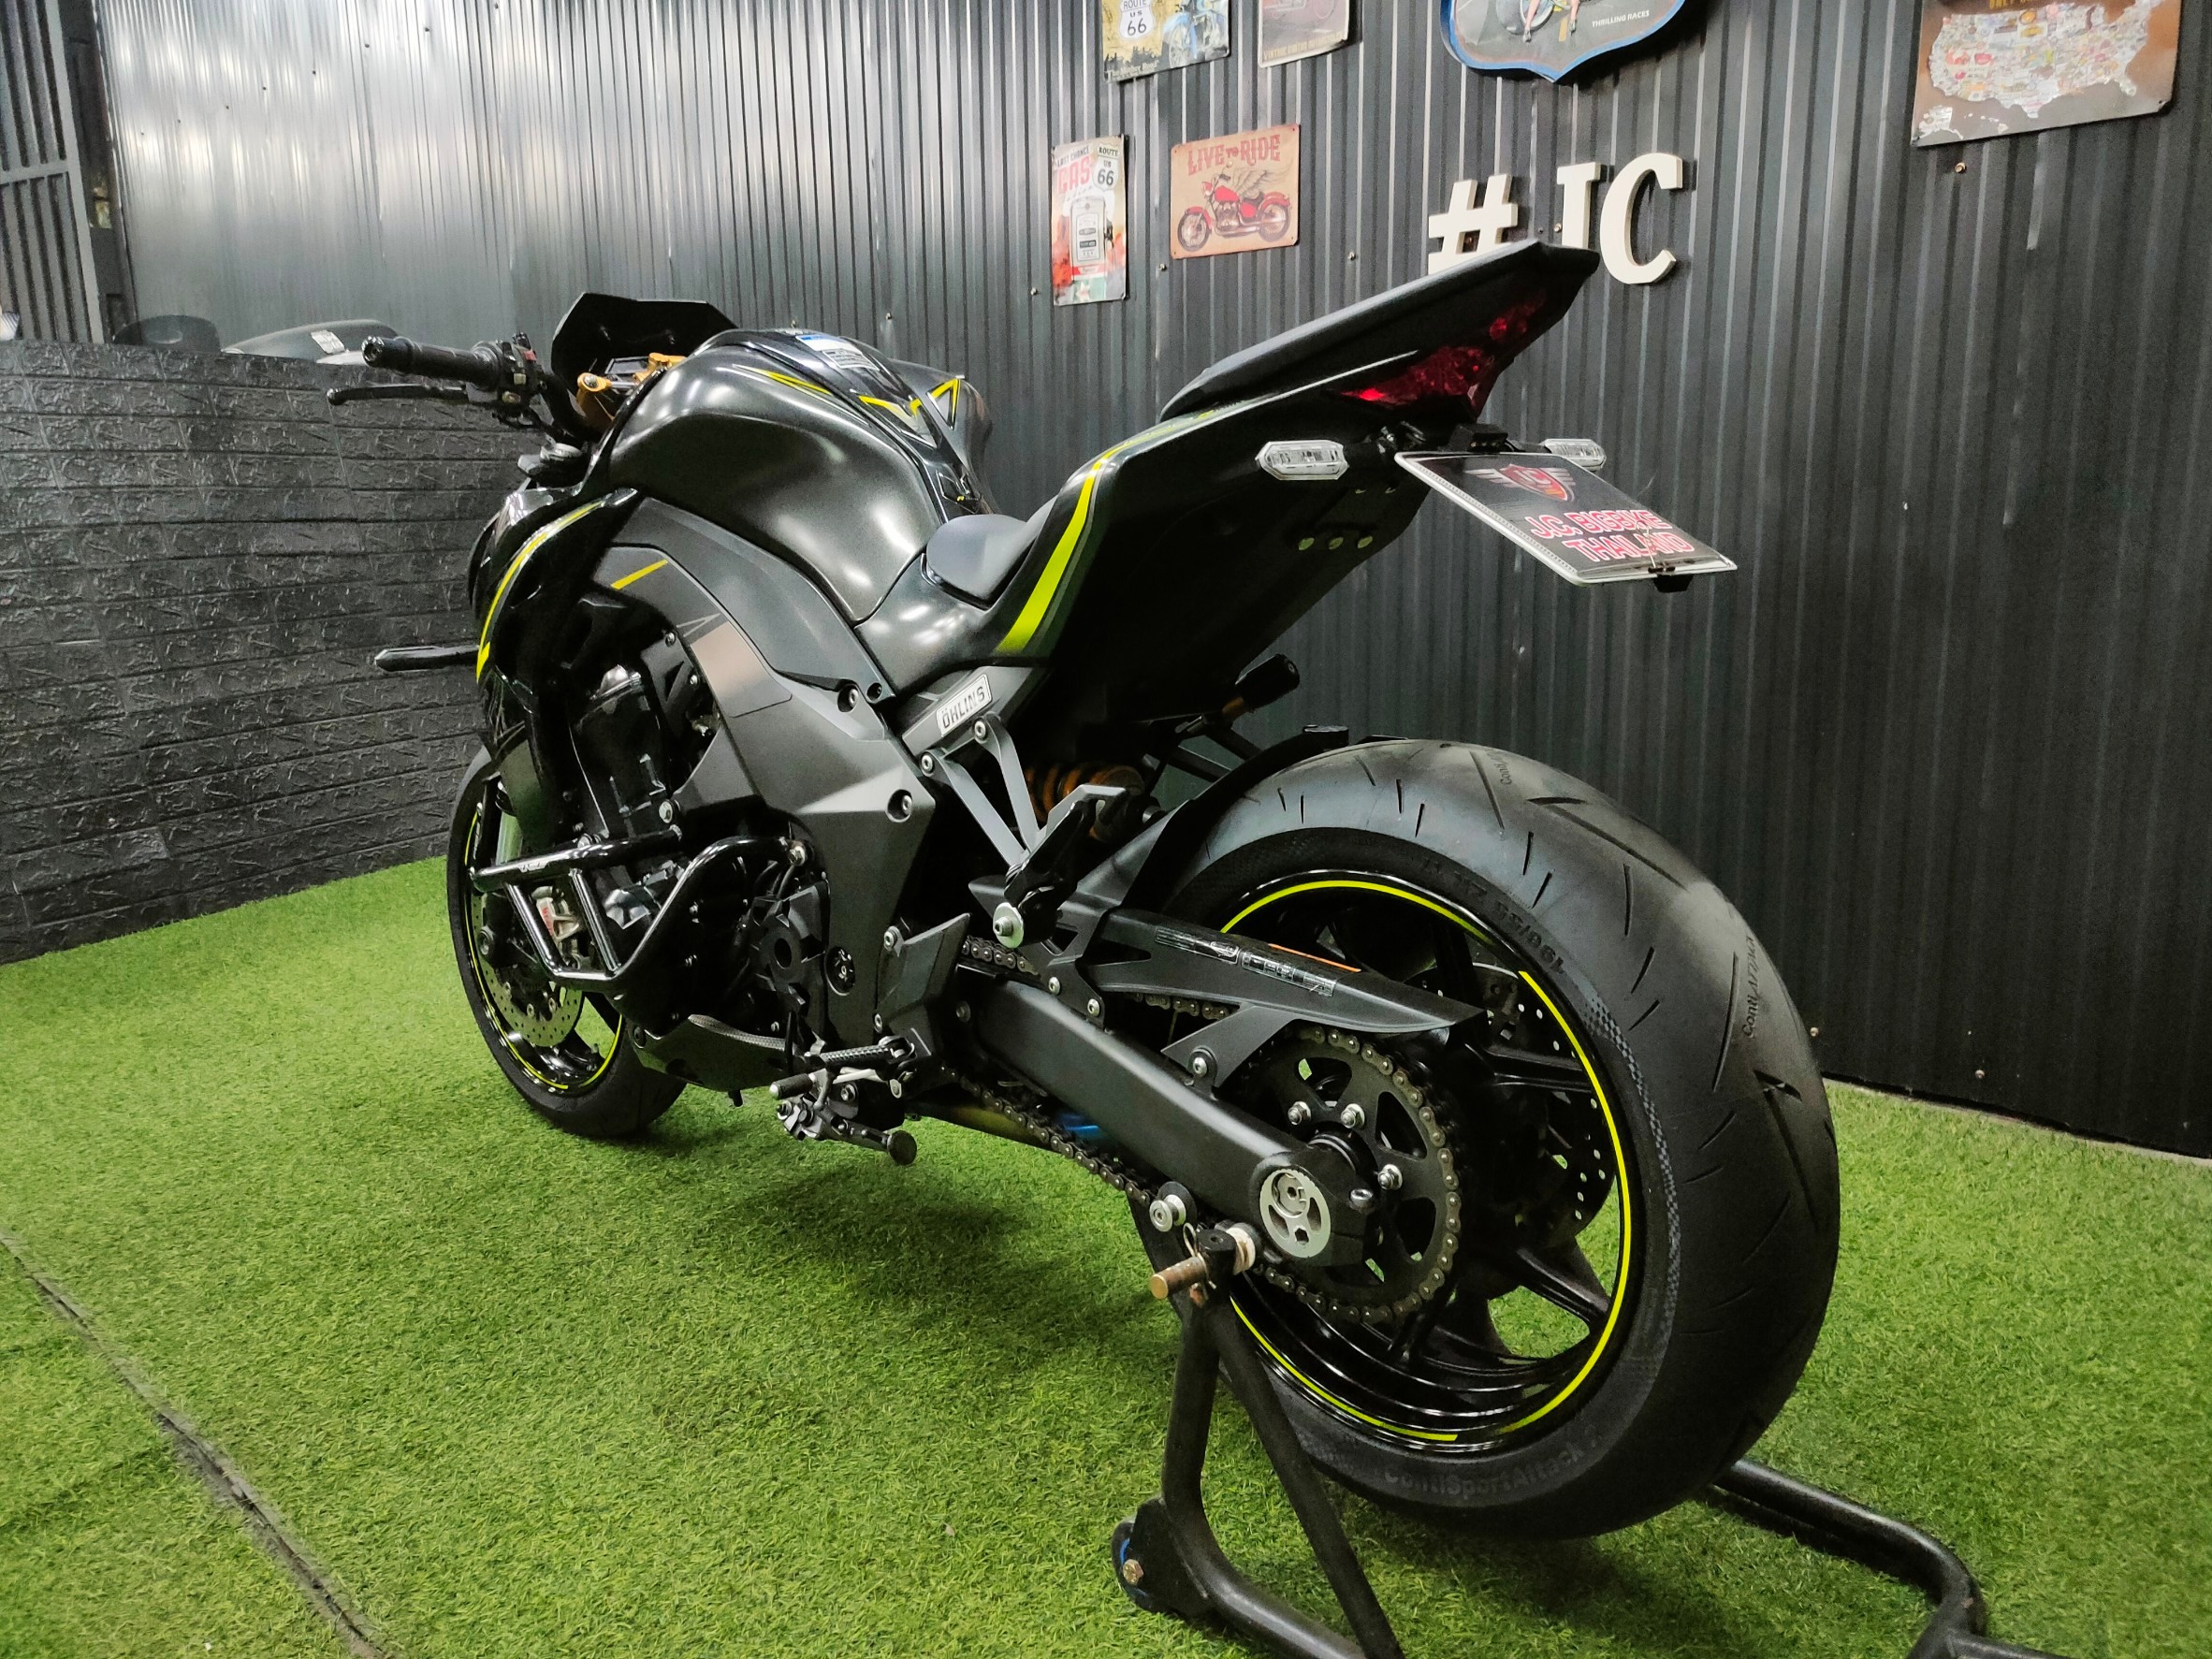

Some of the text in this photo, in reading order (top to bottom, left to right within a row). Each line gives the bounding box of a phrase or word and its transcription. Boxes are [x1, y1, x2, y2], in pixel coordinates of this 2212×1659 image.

[1129, 9, 1142, 18] US
[1592, 10, 1650, 28] THRILLING RACES
[1127, 18, 1147, 36] 66
[1099, 147, 1119, 157] ROUTE
[1187, 144, 1225, 176] LIVE
[1240, 135, 1281, 167] RIDE
[1057, 155, 1091, 195] GAS
[1097, 168, 1114, 186] 66
[1564, 509, 1673, 533] BIGBIKE
[1562, 531, 1695, 562] THAILAND
